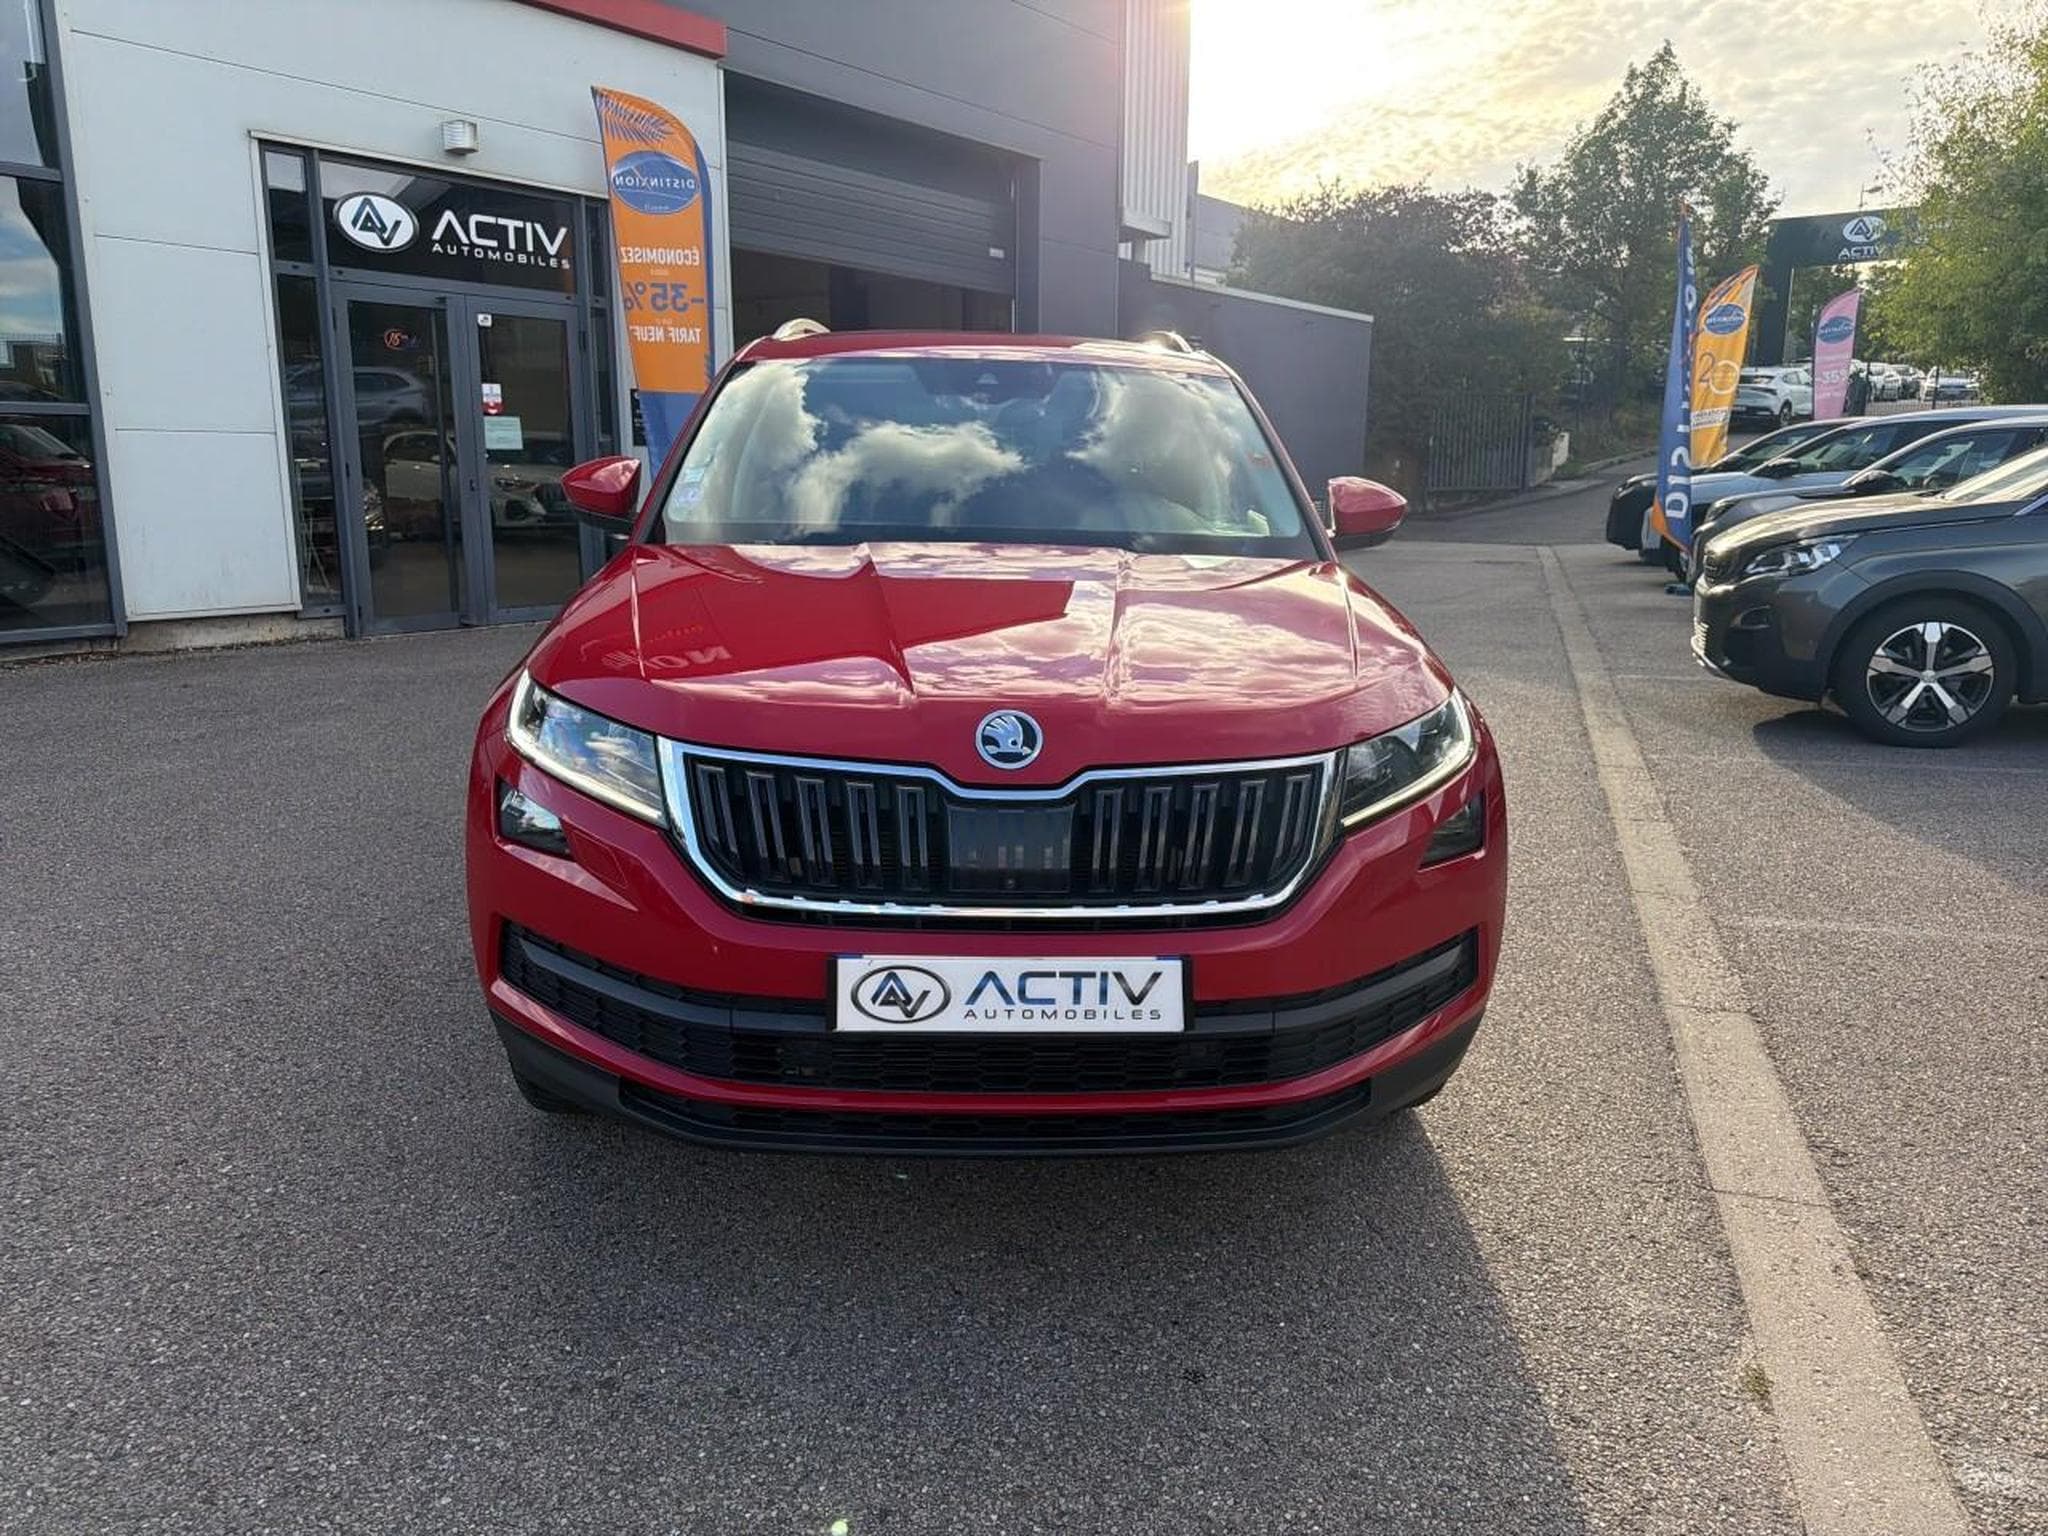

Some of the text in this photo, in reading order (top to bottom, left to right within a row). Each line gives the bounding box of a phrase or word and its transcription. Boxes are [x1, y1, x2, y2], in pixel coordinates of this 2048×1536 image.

[431, 209, 568, 256] ACTIV
[431, 242, 570, 270] AUTOMOBILES
[964, 970, 1163, 1006] ACTIV
[963, 1008, 1161, 1021] AUTOMOBILES
